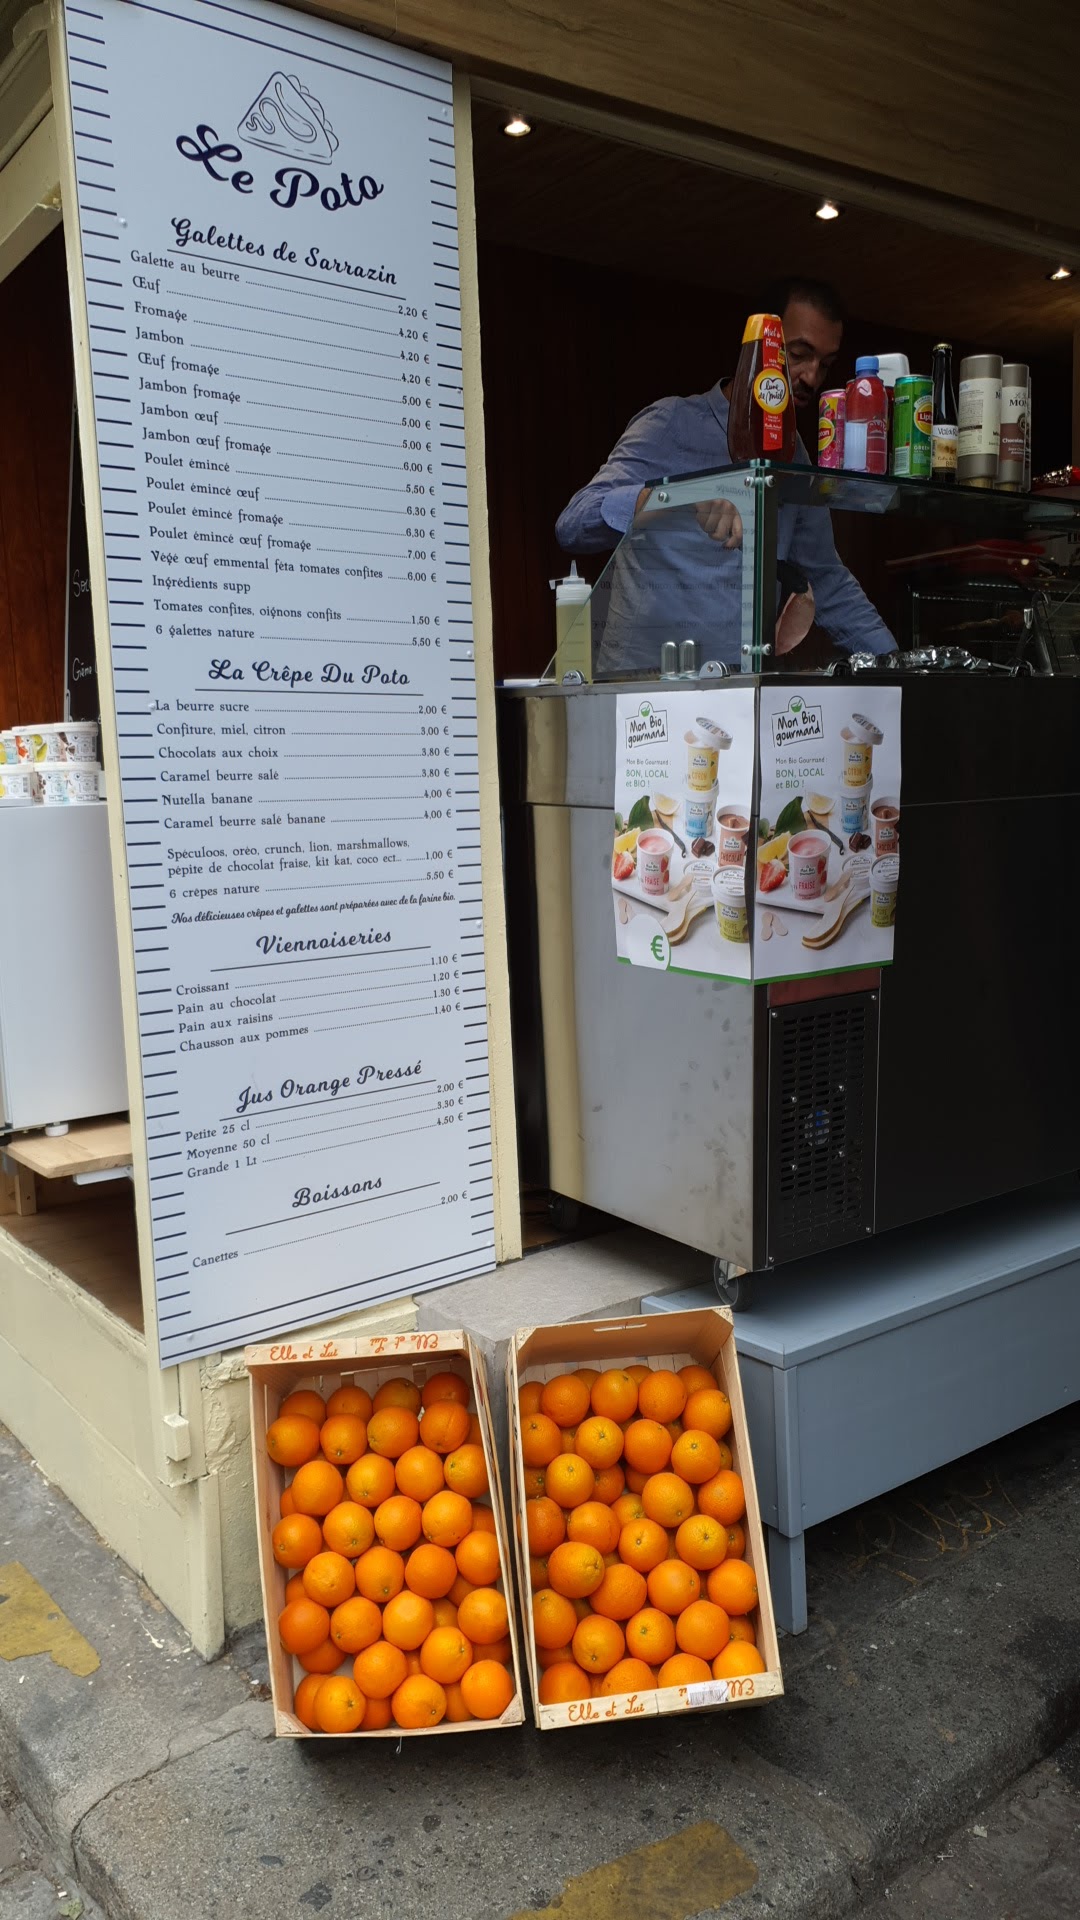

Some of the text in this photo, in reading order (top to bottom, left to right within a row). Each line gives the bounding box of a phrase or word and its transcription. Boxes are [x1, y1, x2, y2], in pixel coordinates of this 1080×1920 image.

[175, 124, 384, 211] Le Poto
[170, 217, 397, 285] Galettes de Sarrazin
[130, 250, 174, 269] Galette
[180, 263, 196, 273] au
[201, 262, 240, 282] beurre
[132, 275, 161, 294] Œuf
[134, 301, 187, 323] Fromage
[135, 326, 184, 345] Jambon
[138, 352, 219, 377] Œuf fromage
[139, 376, 241, 404] Jambon fromage
[144, 451, 183, 467] Poulet
[184, 553, 209, 568] œuf
[213, 557, 269, 570] emmental
[299, 563, 340, 575] tomates
[344, 565, 383, 580] confites
[223, 582, 251, 594] supp
[153, 598, 203, 612] Tomates
[259, 606, 302, 619] oignons
[306, 607, 342, 622] confits
[155, 623, 255, 639] 6 galettes nature
[208, 659, 410, 689] La Crêpe Du Poto
[155, 699, 170, 711] La
[176, 699, 214, 711] beurre
[253, 724, 286, 735] citron
[629, 715, 662, 733] Mon Bio
[777, 711, 816, 730] Mon Bio
[628, 724, 666, 749] gourmand
[775, 720, 821, 747] gourmand
[158, 746, 278, 758] Chocolats aux choix
[775, 757, 787, 765] Mon
[625, 769, 669, 779] BON, LOCAL
[775, 768, 825, 779] BON, LOCAL
[625, 780, 646, 788] et BIO
[775, 780, 800, 790] et BIO
[161, 792, 253, 806] Nutella banane
[264, 841, 305, 854] crunch,
[337, 837, 409, 850] marshmallows,
[208, 861, 222, 873] de
[227, 858, 274, 872] chocolat
[315, 855, 329, 867] kit
[356, 856, 379, 864] coco
[169, 889, 176, 899] 6
[223, 885, 260, 895] nature
[798, 880, 816, 890] FRAISE
[171, 912, 193, 924] Nos
[275, 906, 284, 915] et
[285, 903, 319, 918] galettes
[319, 902, 338, 912] sont
[398, 895, 408, 905] de
[409, 894, 418, 904] la
[418, 893, 442, 906] farine
[256, 928, 391, 955] Viennoiseries
[650, 934, 665, 962] €
[176, 982, 229, 996] Croissant
[177, 1003, 204, 1015] Pain
[209, 1002, 224, 1011] au
[230, 993, 276, 1008] chocolat
[179, 1038, 234, 1052] Chausson
[240, 1034, 260, 1043] aux
[265, 1027, 309, 1042] pommes
[236, 1060, 422, 1114] Jus Orange Pressé
[185, 1119, 250, 1142] Petite 25 cl
[187, 1133, 270, 1160] Moyenne 50 cl
[187, 1160, 229, 1178] Grande
[235, 1160, 239, 1168] 1
[246, 1156, 257, 1166] Lt
[291, 1178, 382, 1208] Boissons
[192, 1251, 238, 1268] Canettes
[269, 1341, 338, 1361] Elle et Lui
[568, 1694, 645, 1722] Elle et Lui
